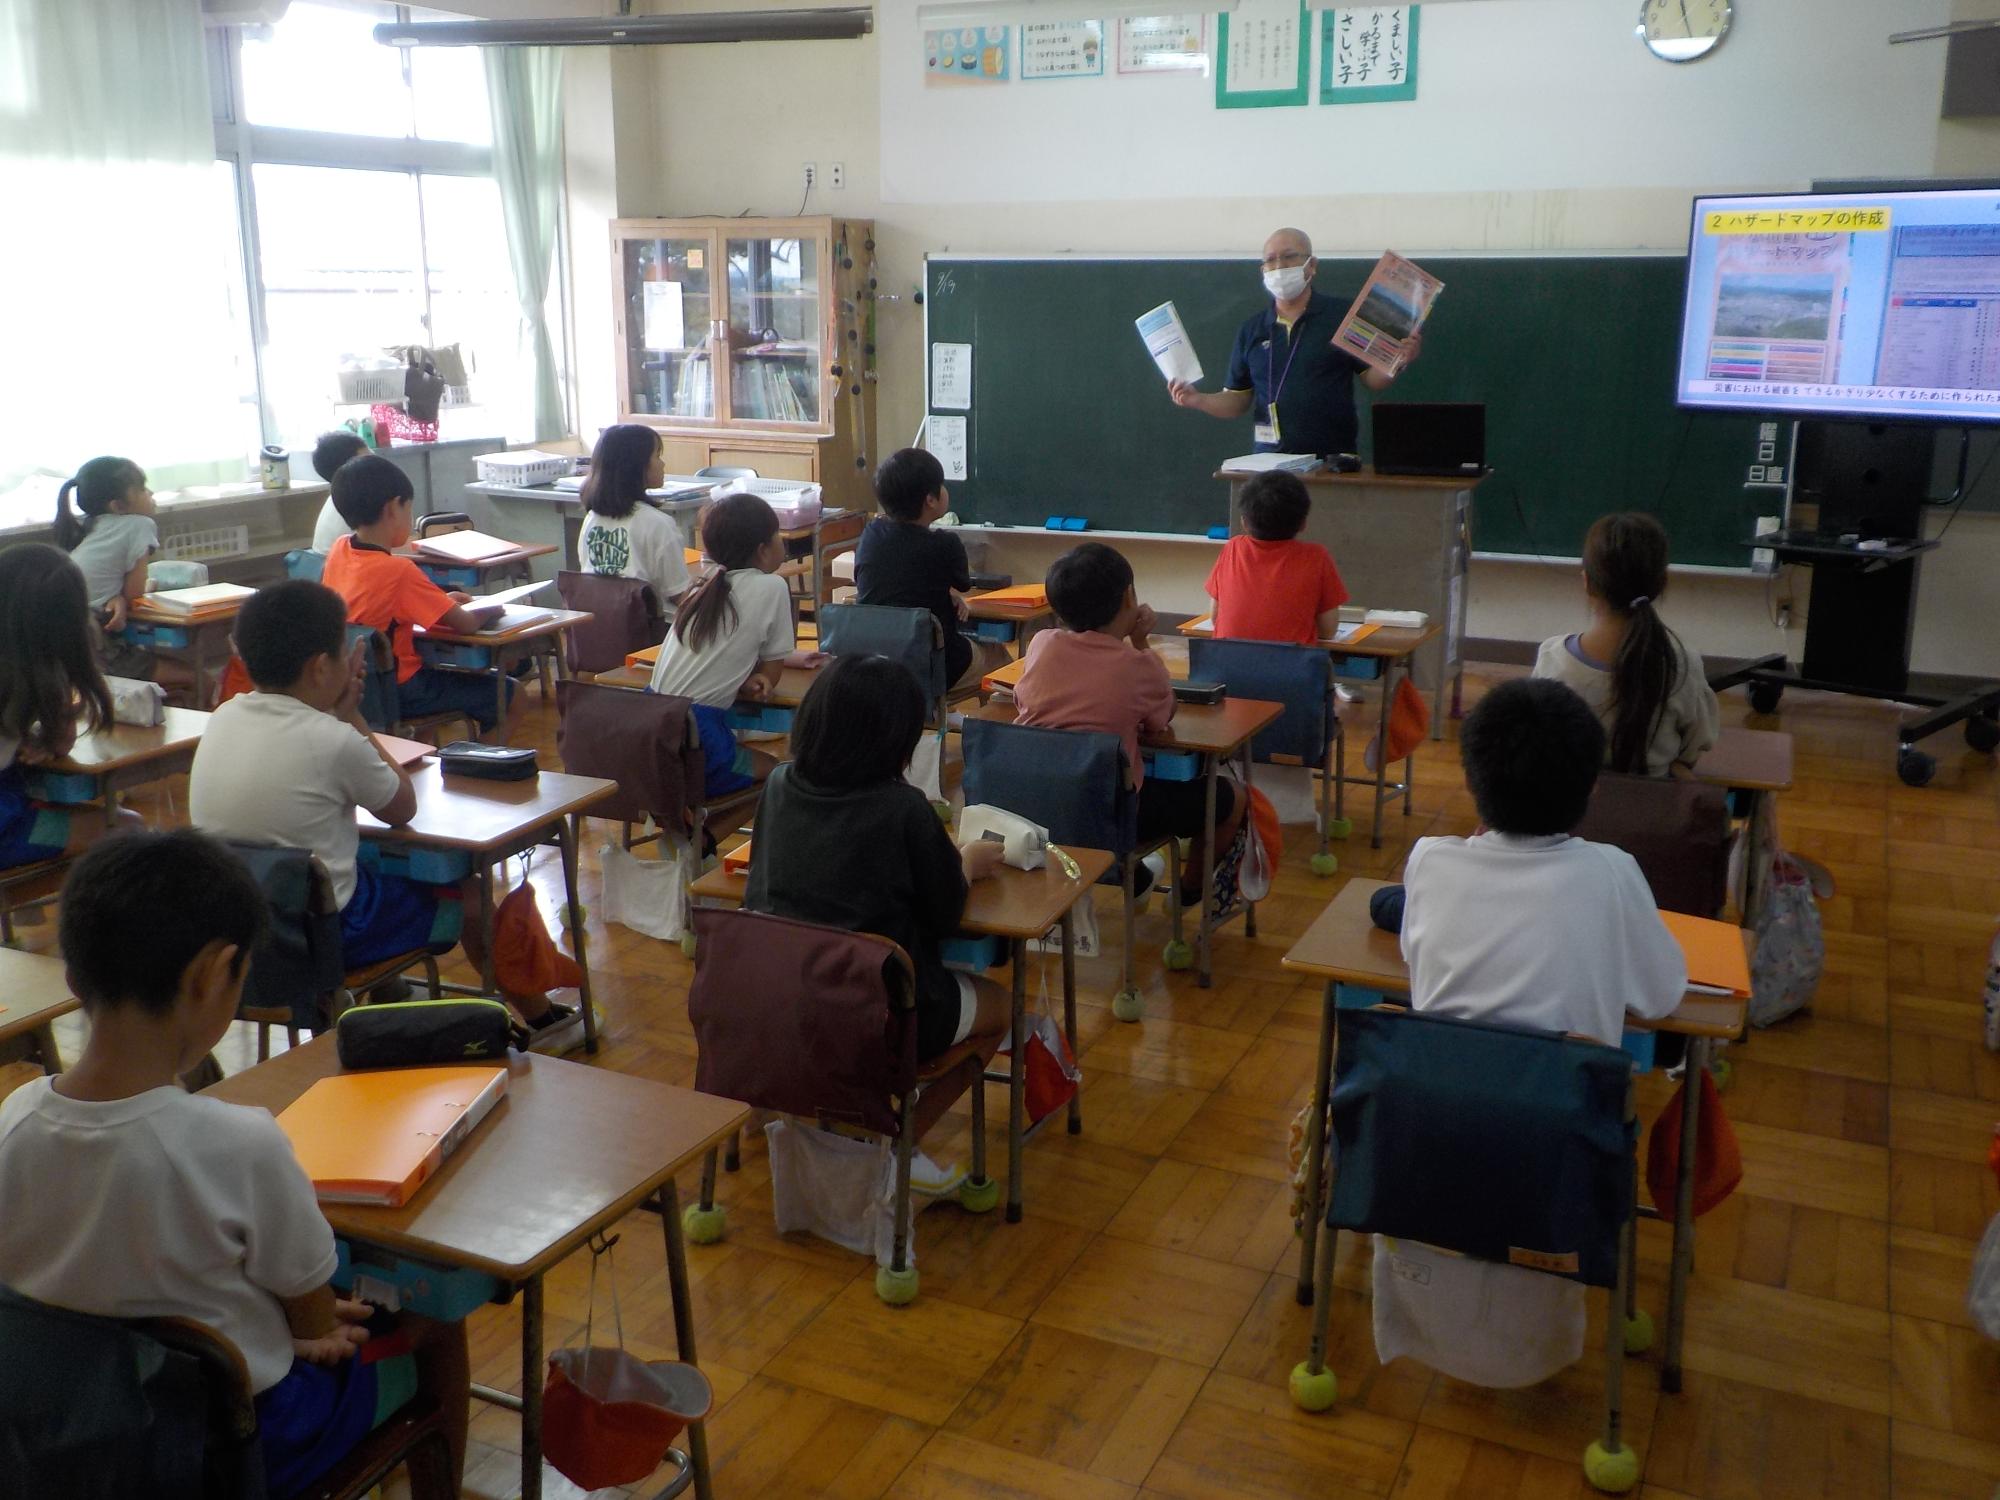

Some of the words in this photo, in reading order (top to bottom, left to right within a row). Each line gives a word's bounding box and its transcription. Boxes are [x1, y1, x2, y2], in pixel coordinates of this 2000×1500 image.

[1357, 30, 1372, 81] 学ぶ子
[1712, 215, 1721, 227] 2
[1729, 211, 1884, 227] ハザードマップの作成
